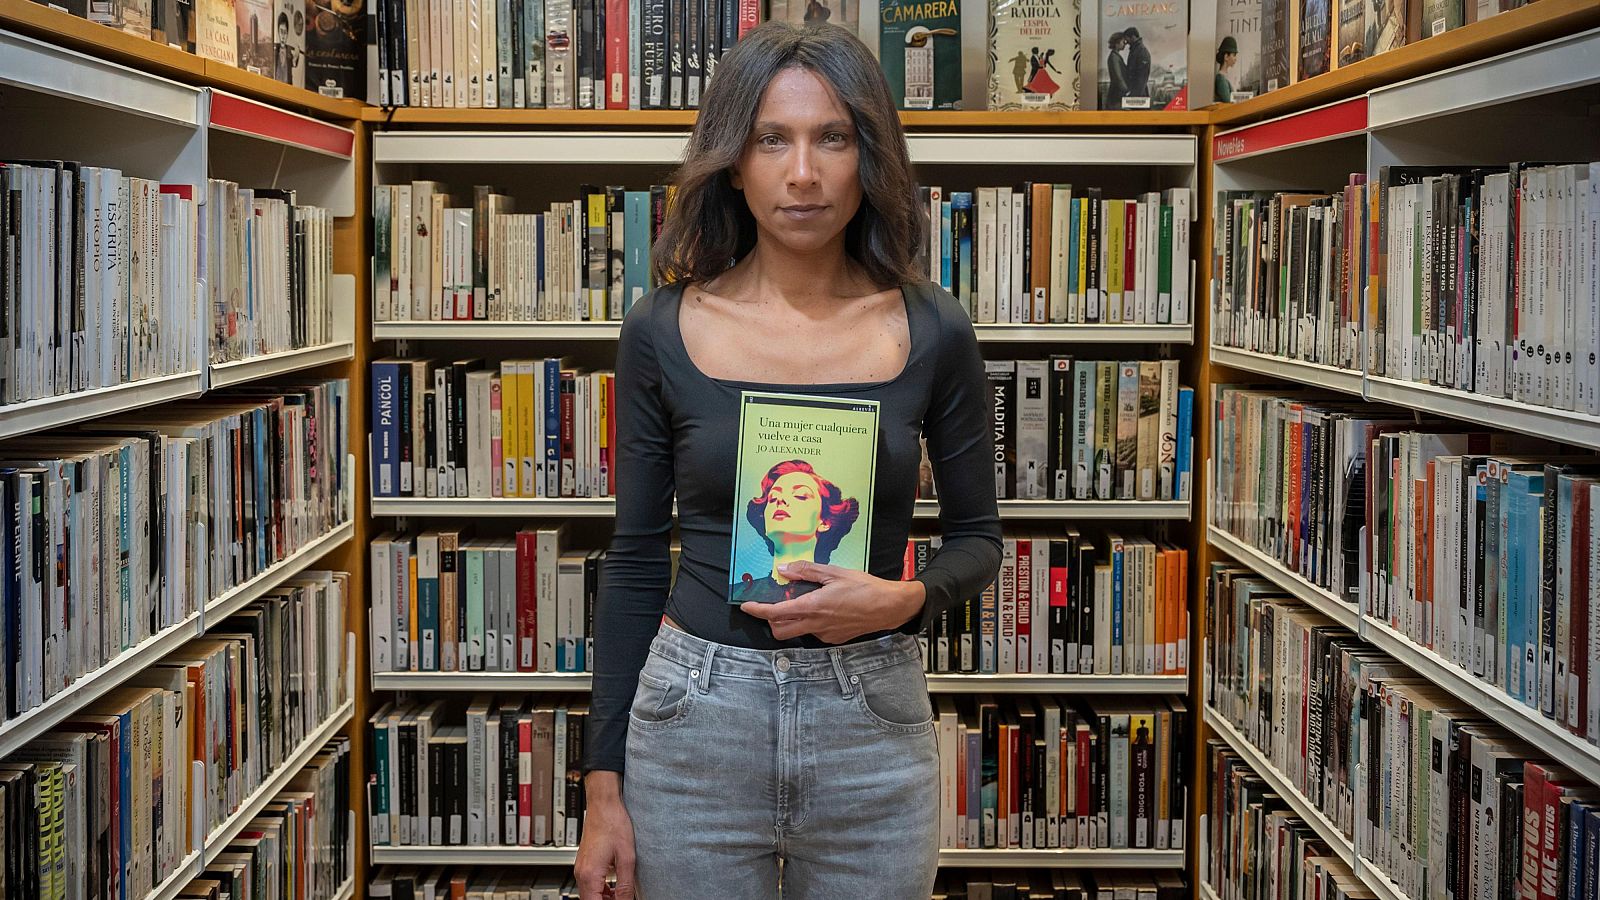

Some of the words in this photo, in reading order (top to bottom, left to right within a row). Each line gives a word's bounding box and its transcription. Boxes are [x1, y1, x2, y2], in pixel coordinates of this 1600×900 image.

[882, 2, 958, 25] CAMARERA
[1010, 7, 1061, 19] RAHOLA
[1034, 28, 1052, 36] RITZ
[1230, 17, 1261, 34] TINT
[215, 31, 230, 46] CASA
[200, 44, 235, 63] VENECIANA
[645, 42, 655, 86] FUEGO
[1426, 210, 1432, 222] EL
[107, 202, 117, 271] ESCRITA
[1425, 272, 1431, 286] DE
[1425, 290, 1431, 303] LA
[1079, 370, 1087, 408] SEPULTURERO
[381, 375, 392, 425] PANCOL
[994, 386, 1005, 441] MALDITA
[759, 416, 781, 429] Una
[783, 420, 814, 433] mujer
[815, 423, 868, 436] cualquiera
[1102, 408, 1110, 443] SEPULTURERO
[758, 431, 791, 442] vuelve
[800, 436, 822, 444] casa
[1162, 432, 1173, 464] NCO
[756, 444, 768, 454] JO
[768, 446, 822, 456] ALEXANDER
[994, 444, 1005, 463] RO
[396, 550, 404, 573] JAMES
[1018, 555, 1030, 592] PRESTON
[396, 573, 404, 616] PATTERSON
[1002, 566, 1014, 603] PRESTON
[1018, 592, 1029, 600] &
[982, 610, 994, 619] &
[1002, 604, 1014, 612] &
[1018, 602, 1029, 624] CHILD
[1002, 613, 1014, 638] CHILD
[1544, 804, 1555, 851] VICTUS
[1571, 822, 1579, 854] Albert
[1474, 844, 1479, 856] EN
